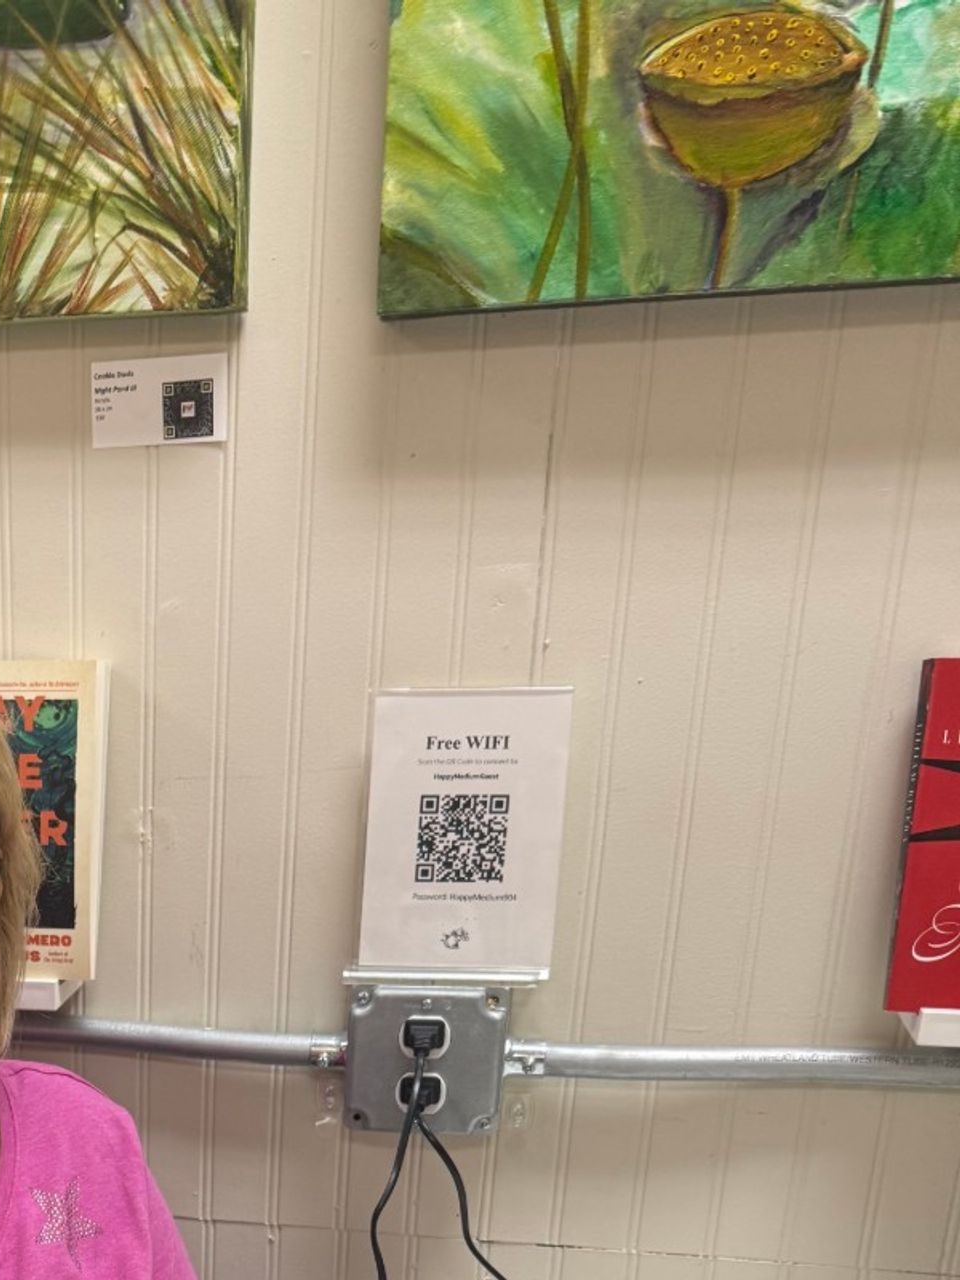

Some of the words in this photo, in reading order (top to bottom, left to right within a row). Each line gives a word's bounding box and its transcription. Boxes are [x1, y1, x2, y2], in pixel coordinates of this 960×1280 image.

[425, 735, 461, 751] Free
[466, 735, 511, 751] WIFI
[25, 934, 72, 947] MERO
